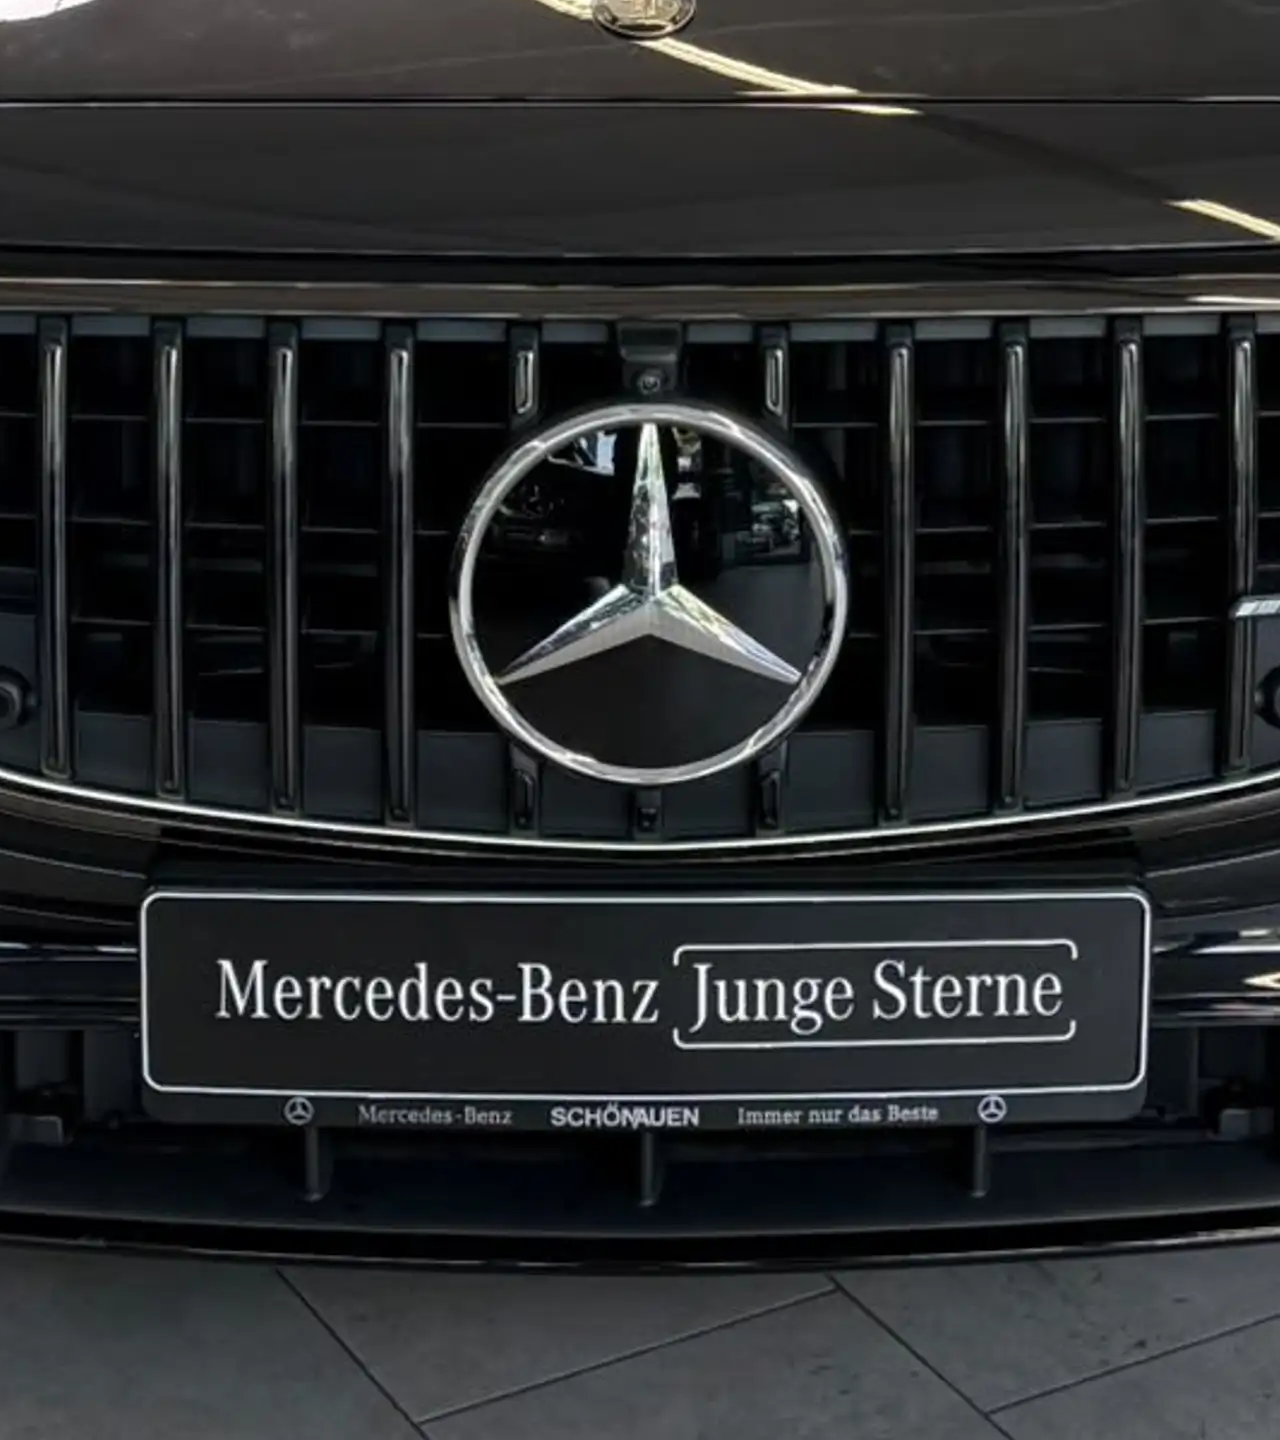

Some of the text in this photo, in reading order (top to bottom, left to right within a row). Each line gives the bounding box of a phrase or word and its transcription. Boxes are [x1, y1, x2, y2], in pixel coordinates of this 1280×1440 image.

[216, 958, 1064, 1036] Mercedes-Benz Junge Sterne
[358, 1102, 939, 1129] Mercedes-Benz SCHÖNAUEN Immer nur das Beste
